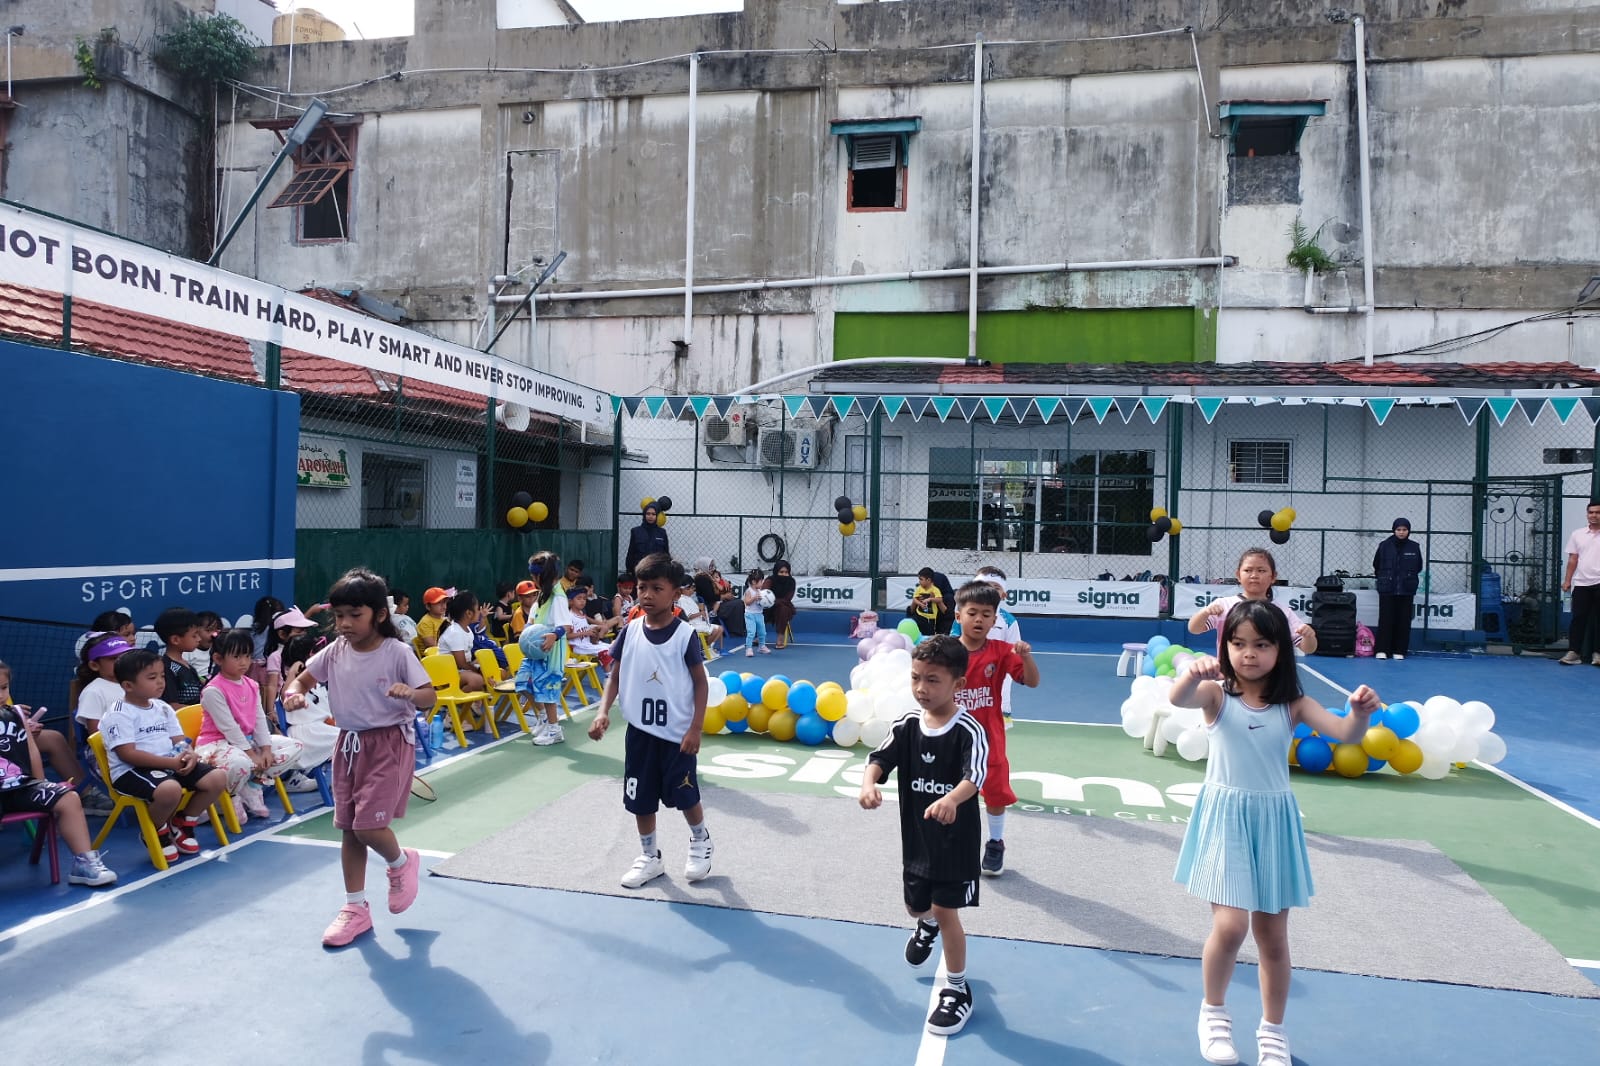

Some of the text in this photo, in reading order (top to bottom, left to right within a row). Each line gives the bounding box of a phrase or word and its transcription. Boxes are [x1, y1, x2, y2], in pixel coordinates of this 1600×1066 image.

[257, 298, 322, 340] HARD,
[328, 320, 375, 349] PLAY
[379, 335, 431, 365] SMART
[434, 354, 463, 373] AND
[466, 360, 504, 385] NEVER
[506, 375, 533, 393] STOP
[535, 381, 585, 410] IMPROVING.
[800, 438, 810, 464] AUX
[82, 572, 260, 602] SPORT CENTER
[796, 583, 854, 604] sigma
[1077, 587, 1140, 609] sigma
[954, 686, 991, 702] SEMEN
[641, 697, 668, 727] 08
